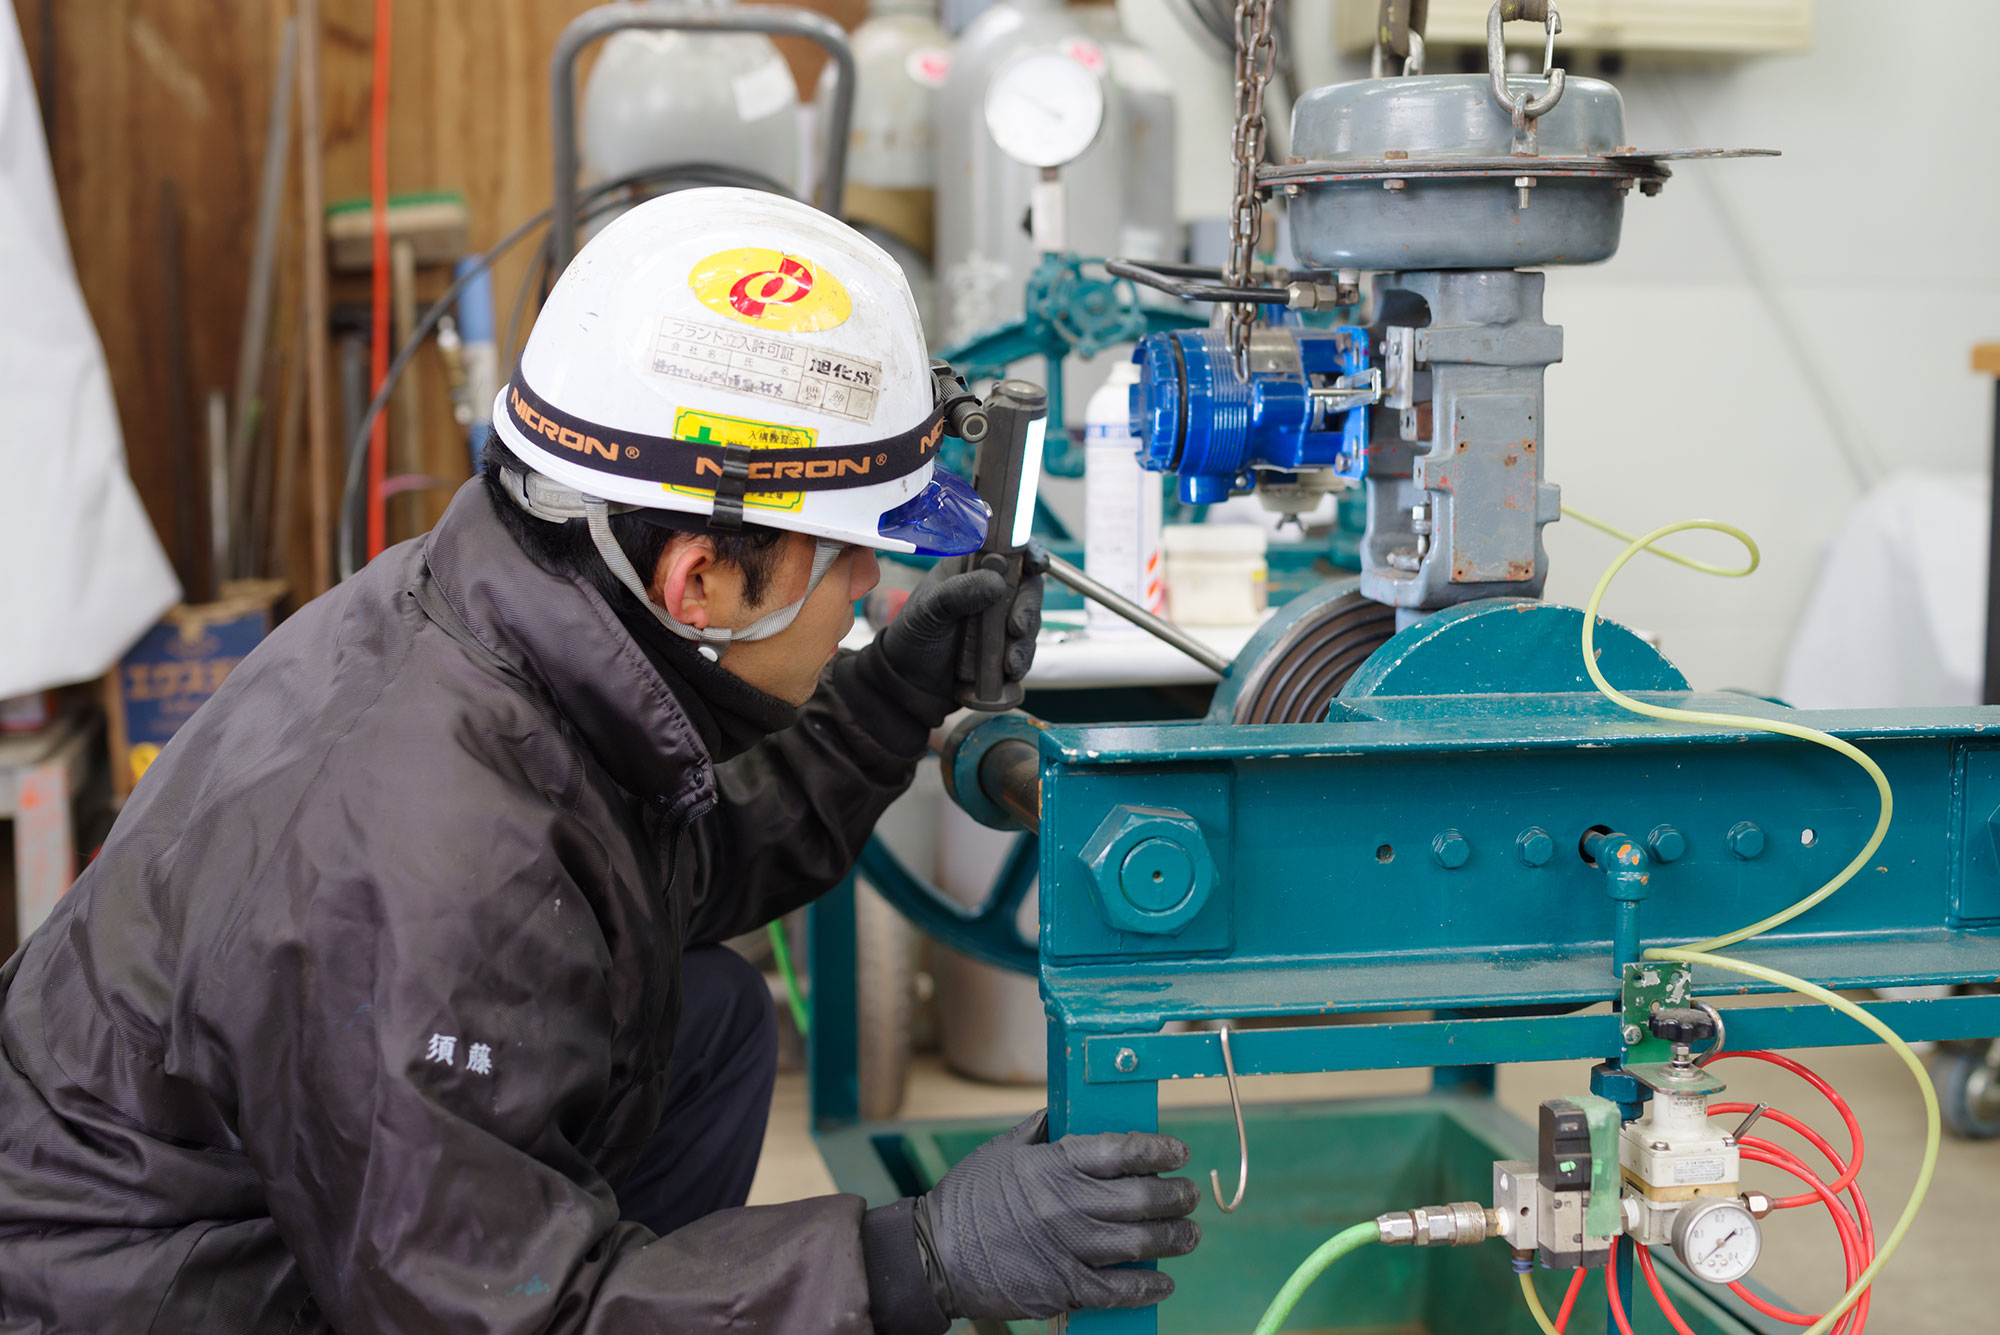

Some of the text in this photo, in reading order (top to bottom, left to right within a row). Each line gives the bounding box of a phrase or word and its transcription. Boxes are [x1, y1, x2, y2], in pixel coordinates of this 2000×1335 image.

[510, 387, 620, 462] NICRON
[695, 456, 871, 479] NCRON
[425, 1033, 493, 1075] 須藤
